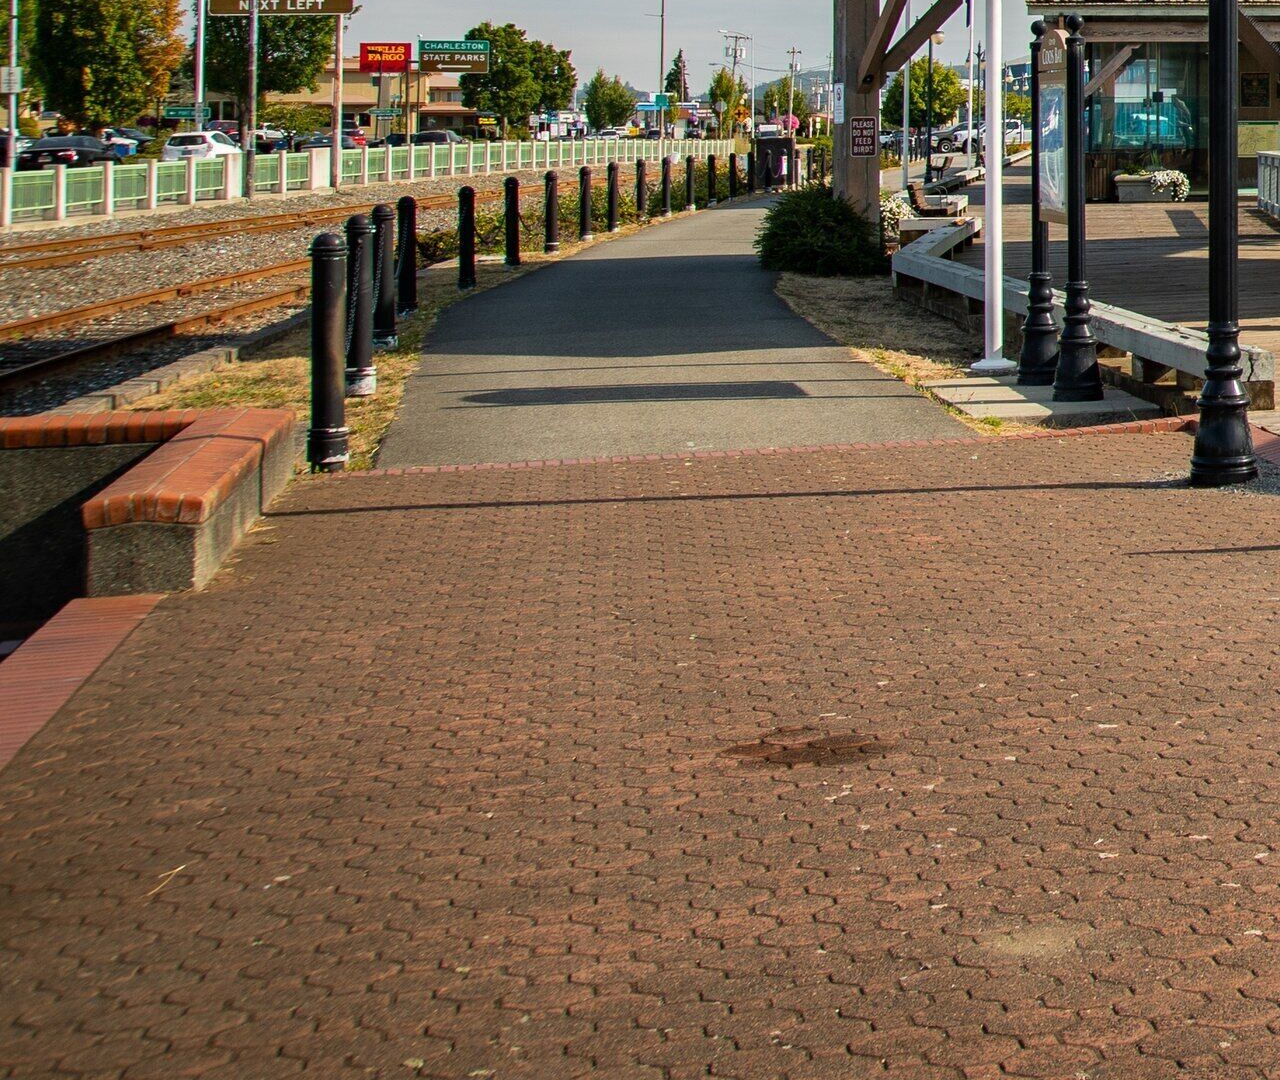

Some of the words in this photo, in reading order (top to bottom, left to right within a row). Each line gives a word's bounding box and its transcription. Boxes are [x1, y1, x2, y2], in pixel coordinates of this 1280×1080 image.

[239, 0, 279, 10] NXT
[287, 0, 325, 10] LEFT
[424, 42, 484, 50] CHARLESTON
[368, 53, 405, 61] FARGO
[855, 137, 872, 145] FEED
